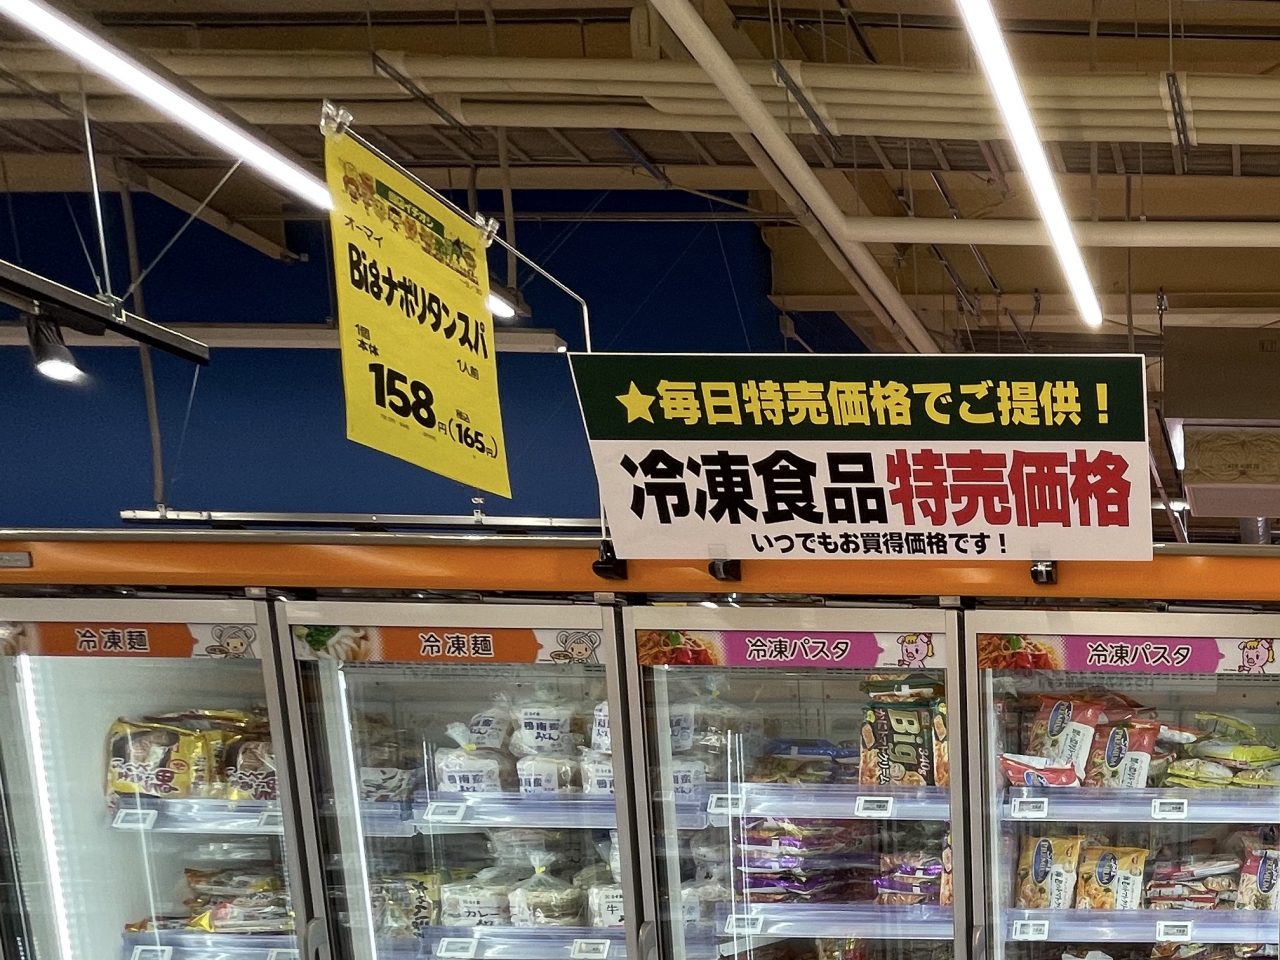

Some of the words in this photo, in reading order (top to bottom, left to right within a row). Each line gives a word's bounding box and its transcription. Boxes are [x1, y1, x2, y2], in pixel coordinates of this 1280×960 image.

[343, 214, 384, 249] オーマイ
[348, 242, 488, 360] Bigナポリタンスパ
[657, 380, 1110, 426] 毎日特売価格でご提供！
[620, 449, 1131, 527] 冷凍食品特売価格
[752, 531, 1007, 556] いつでもお買得価格です！
[74, 629, 150, 652] 冷凍麺
[419, 633, 494, 657] 冷凍麺
[746, 636, 850, 662] 冷凍パスタ
[1086, 641, 1193, 667] 冷凍パスタ
[887, 708, 921, 765] Big
